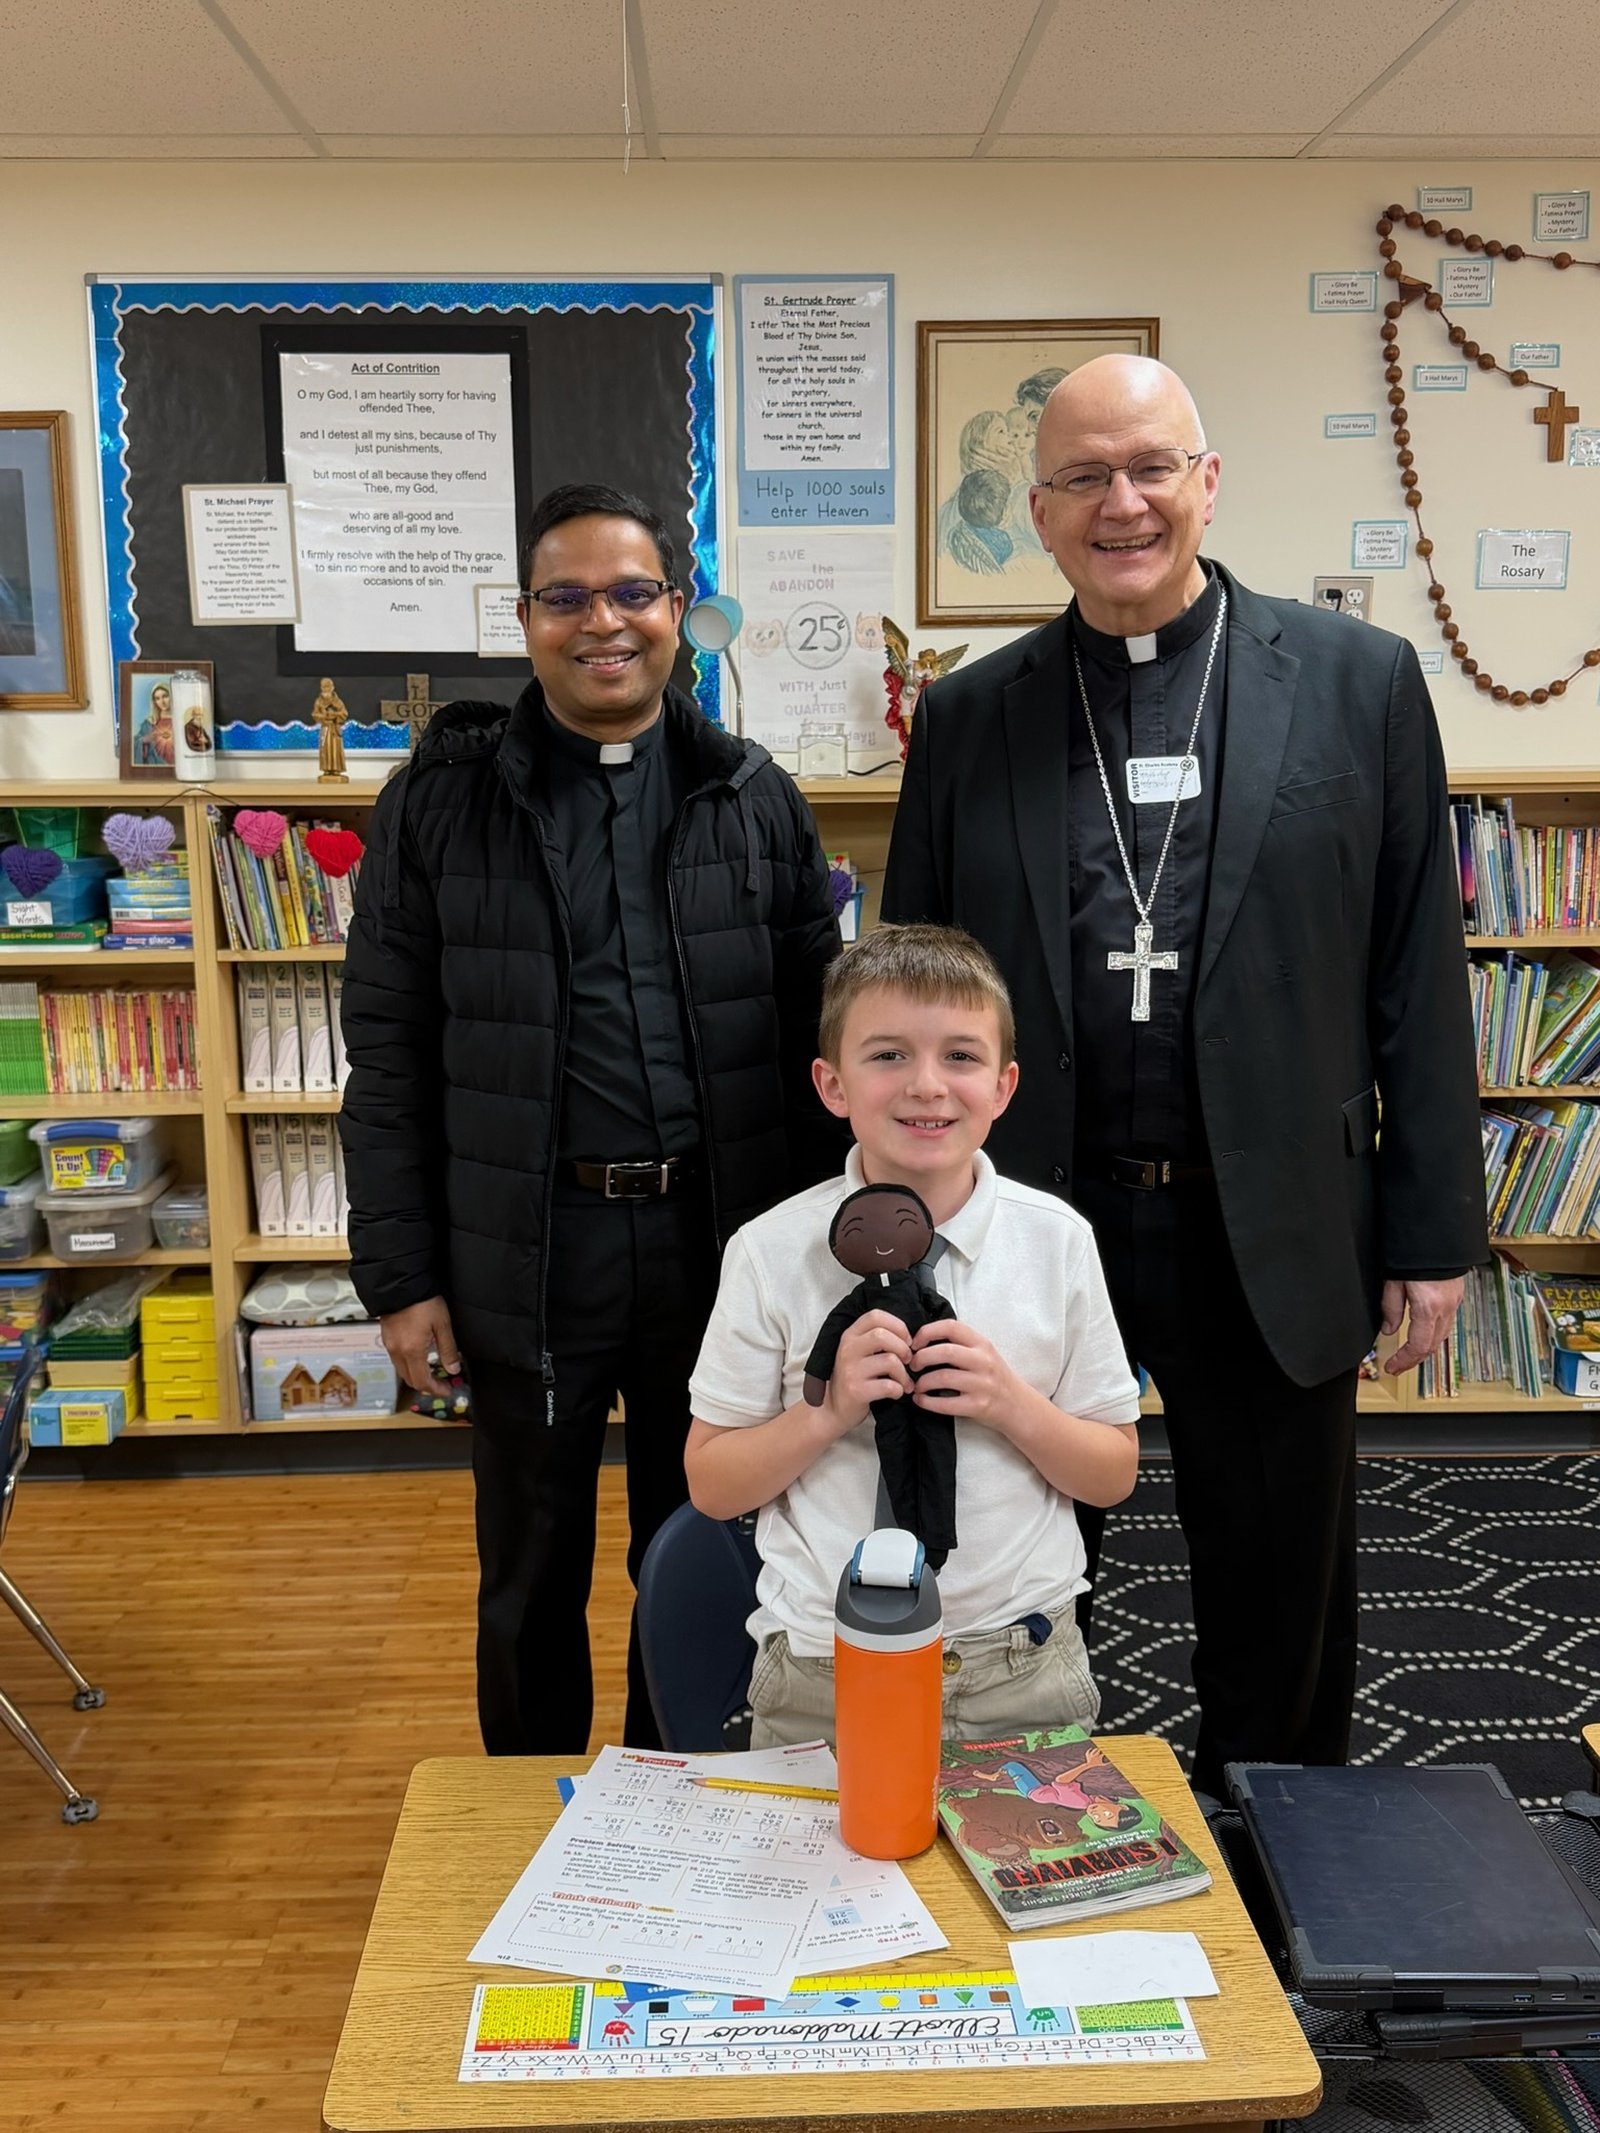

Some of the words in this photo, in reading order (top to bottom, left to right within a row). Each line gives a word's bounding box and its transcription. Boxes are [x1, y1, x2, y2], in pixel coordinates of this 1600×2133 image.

[1551, 202, 1567, 210] Glory
[1544, 210, 1562, 218] Fatima
[1564, 209, 1583, 218] Prayer
[1552, 218, 1575, 227] Mystery
[763, 296, 779, 306] St.
[782, 296, 824, 306] Gertrude
[825, 296, 857, 306] Prayer
[780, 309, 808, 317] Eternal
[811, 309, 839, 318] Father,
[750, 321, 755, 329] I
[758, 321, 778, 329] offer
[803, 320, 815, 328] the
[840, 320, 870, 328] Precious
[764, 332, 784, 340] Blood
[786, 332, 795, 340] of
[798, 333, 812, 342] Thy
[815, 332, 837, 340] Divine
[840, 331, 857, 340] Son,
[798, 343, 822, 351] Jesus,
[351, 363, 370, 373] Act
[372, 363, 383, 373] of
[386, 363, 440, 373] Contrition
[297, 389, 307, 399] O
[309, 392, 325, 402] my
[327, 389, 352, 400] God,
[354, 389, 358, 399] I
[379, 390, 416, 402] heartily
[419, 392, 444, 402] sorry
[446, 390, 460, 400] for
[462, 390, 496, 402] having
[359, 403, 403, 413] offended
[406, 403, 435, 414] Thee,
[300, 429, 319, 439] and
[322, 429, 325, 439] I
[327, 430, 359, 440] detest
[361, 430, 373, 440] all
[375, 432, 391, 442] my
[394, 430, 417, 441] sins,
[419, 430, 463, 440] because
[465, 430, 475, 440] of
[477, 430, 497, 442] Thy
[763, 433, 783, 441] those
[355, 443, 373, 455] just
[375, 443, 442, 455] punishments,
[804, 445, 817, 454] my
[818, 443, 843, 453] family.
[800, 455, 824, 464] Amen.
[313, 470, 329, 479] but
[332, 471, 357, 479] most
[359, 470, 369, 479] of
[371, 470, 383, 479] all
[385, 470, 429, 480] because
[430, 470, 453, 482] they
[455, 470, 487, 481] offend
[364, 483, 393, 494] Thee,
[395, 485, 411, 495] my
[413, 483, 438, 494] God,
[757, 477, 794, 502] Help
[806, 481, 842, 496] 1000
[849, 480, 886, 496] souls
[216, 498, 247, 506] Michael
[248, 497, 274, 507] Prayer
[771, 505, 808, 519] enter
[818, 501, 869, 519] Heaven
[349, 511, 370, 520] who
[373, 512, 390, 521] are
[392, 510, 432, 523] all-good
[434, 511, 454, 521] and
[343, 524, 391, 536] deserving
[393, 524, 404, 534] of
[406, 524, 418, 534] all
[420, 526, 436, 536] my
[437, 524, 462, 534] love.
[301, 550, 304, 558] I
[307, 550, 334, 561] firmly
[337, 550, 373, 559] resolve
[375, 550, 396, 560] with
[398, 550, 415, 561] the
[416, 550, 439, 562] help
[440, 550, 451, 561] of
[453, 550, 472, 562] Thy
[474, 552, 506, 563] grace,
[767, 549, 806, 562] SAVE
[1512, 544, 1536, 558] The
[315, 564, 325, 572] to
[327, 564, 342, 572] sin
[360, 565, 386, 573] more
[388, 563, 408, 573] and
[410, 564, 420, 573] to
[422, 563, 449, 573] avoid
[451, 563, 468, 572] the
[470, 565, 493, 574] near
[812, 563, 834, 575] the
[1500, 565, 1545, 580] Rosary
[363, 576, 414, 586] occasions
[415, 576, 426, 586] of
[428, 577, 446, 586] sin.
[769, 578, 835, 593] ABANDON
[390, 602, 422, 612] Amen.
[779, 681, 815, 693] WITH
[819, 679, 848, 691] Just
[784, 703, 847, 716] QUARTER
[1131, 763, 1140, 799] VISITOR
[11, 903, 36, 915] Sight
[16, 914, 45, 924] Words
[148, 936, 176, 944] BINGO
[278, 966, 286, 981] 2
[305, 966, 316, 980] 3
[55, 1153, 84, 1163] Count
[56, 1163, 65, 1171] It
[66, 1161, 84, 1172] Up!
[1544, 1288, 1574, 1300] FLY
[962, 1740, 1018, 1750] SCHOLASTIC
[569, 1837, 605, 1846] Problem
[606, 1841, 636, 1850] Solving
[1157, 1838, 1180, 1856] I
[994, 1842, 1159, 1888] SURVIVED
[1123, 1865, 1142, 1875] THE
[1083, 1870, 1123, 1883] GRAPHIC
[1052, 1878, 1083, 1889] NOVEL
[1021, 1896, 1060, 1906] TARSHIS
[877, 1936, 899, 1944] Prep
[902, 1931, 921, 1940] Test
[704, 2022, 882, 2043] Maldonado
[888, 2016, 1000, 2041] Elliott
[659, 2026, 690, 2047] 15
